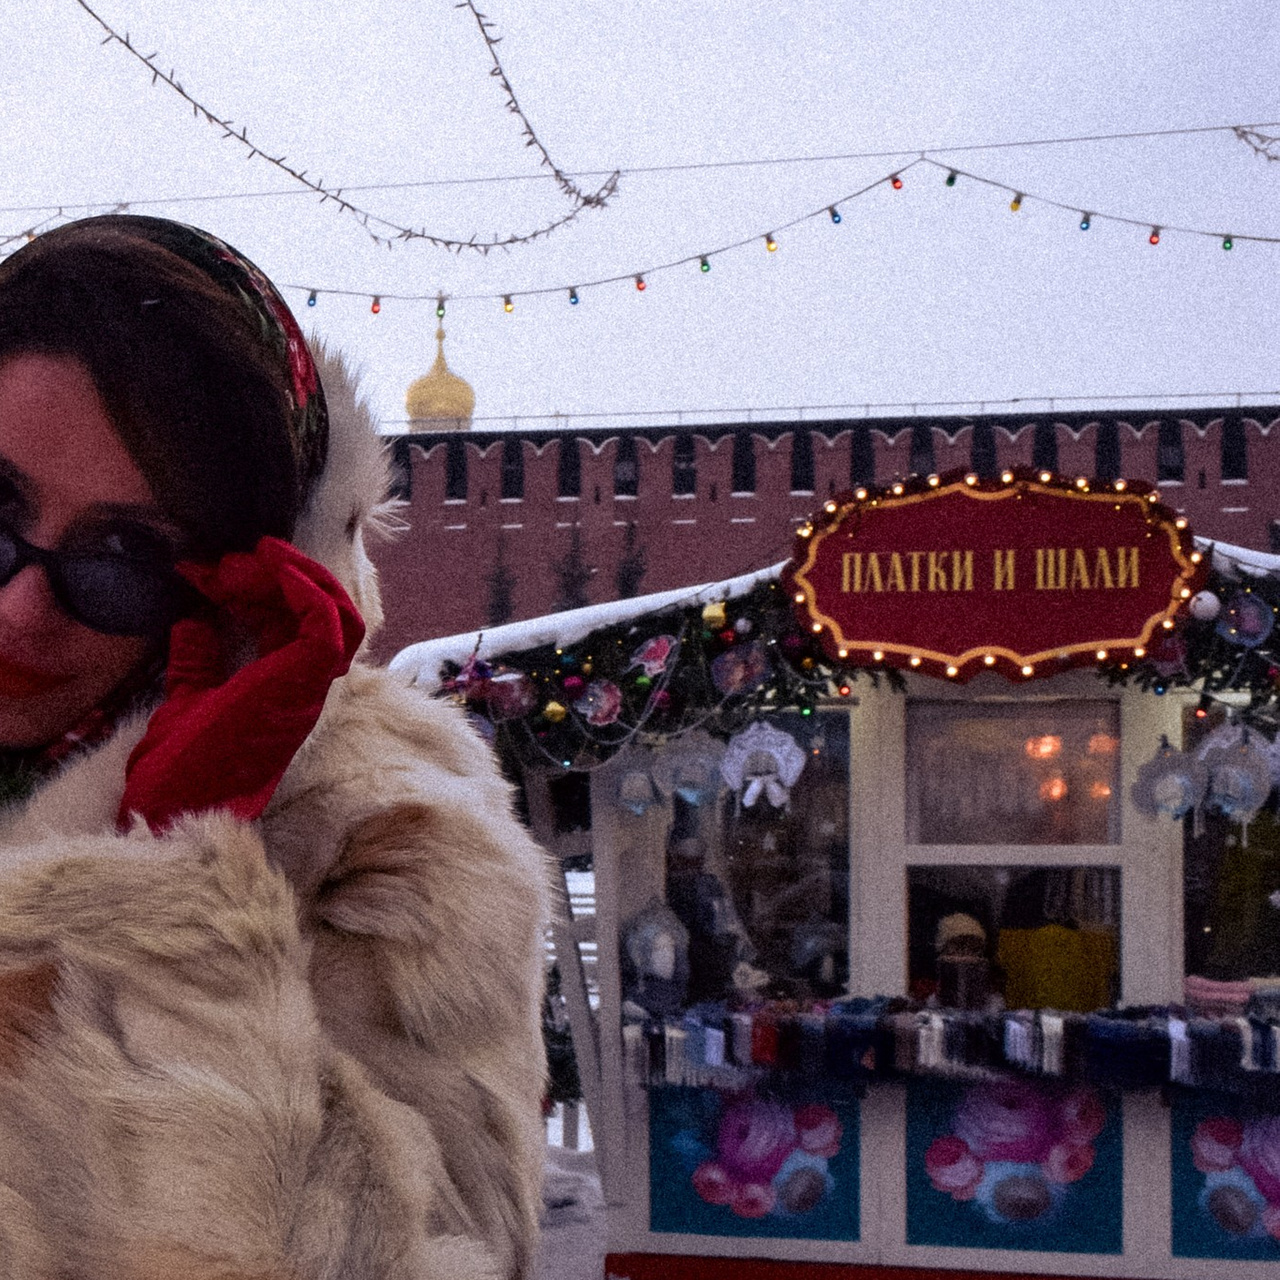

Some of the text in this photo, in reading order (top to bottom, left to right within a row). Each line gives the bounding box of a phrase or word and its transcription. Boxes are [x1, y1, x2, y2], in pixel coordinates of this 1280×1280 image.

[841, 547, 1141, 593] ПЛАТКИ И ШАЛИ
